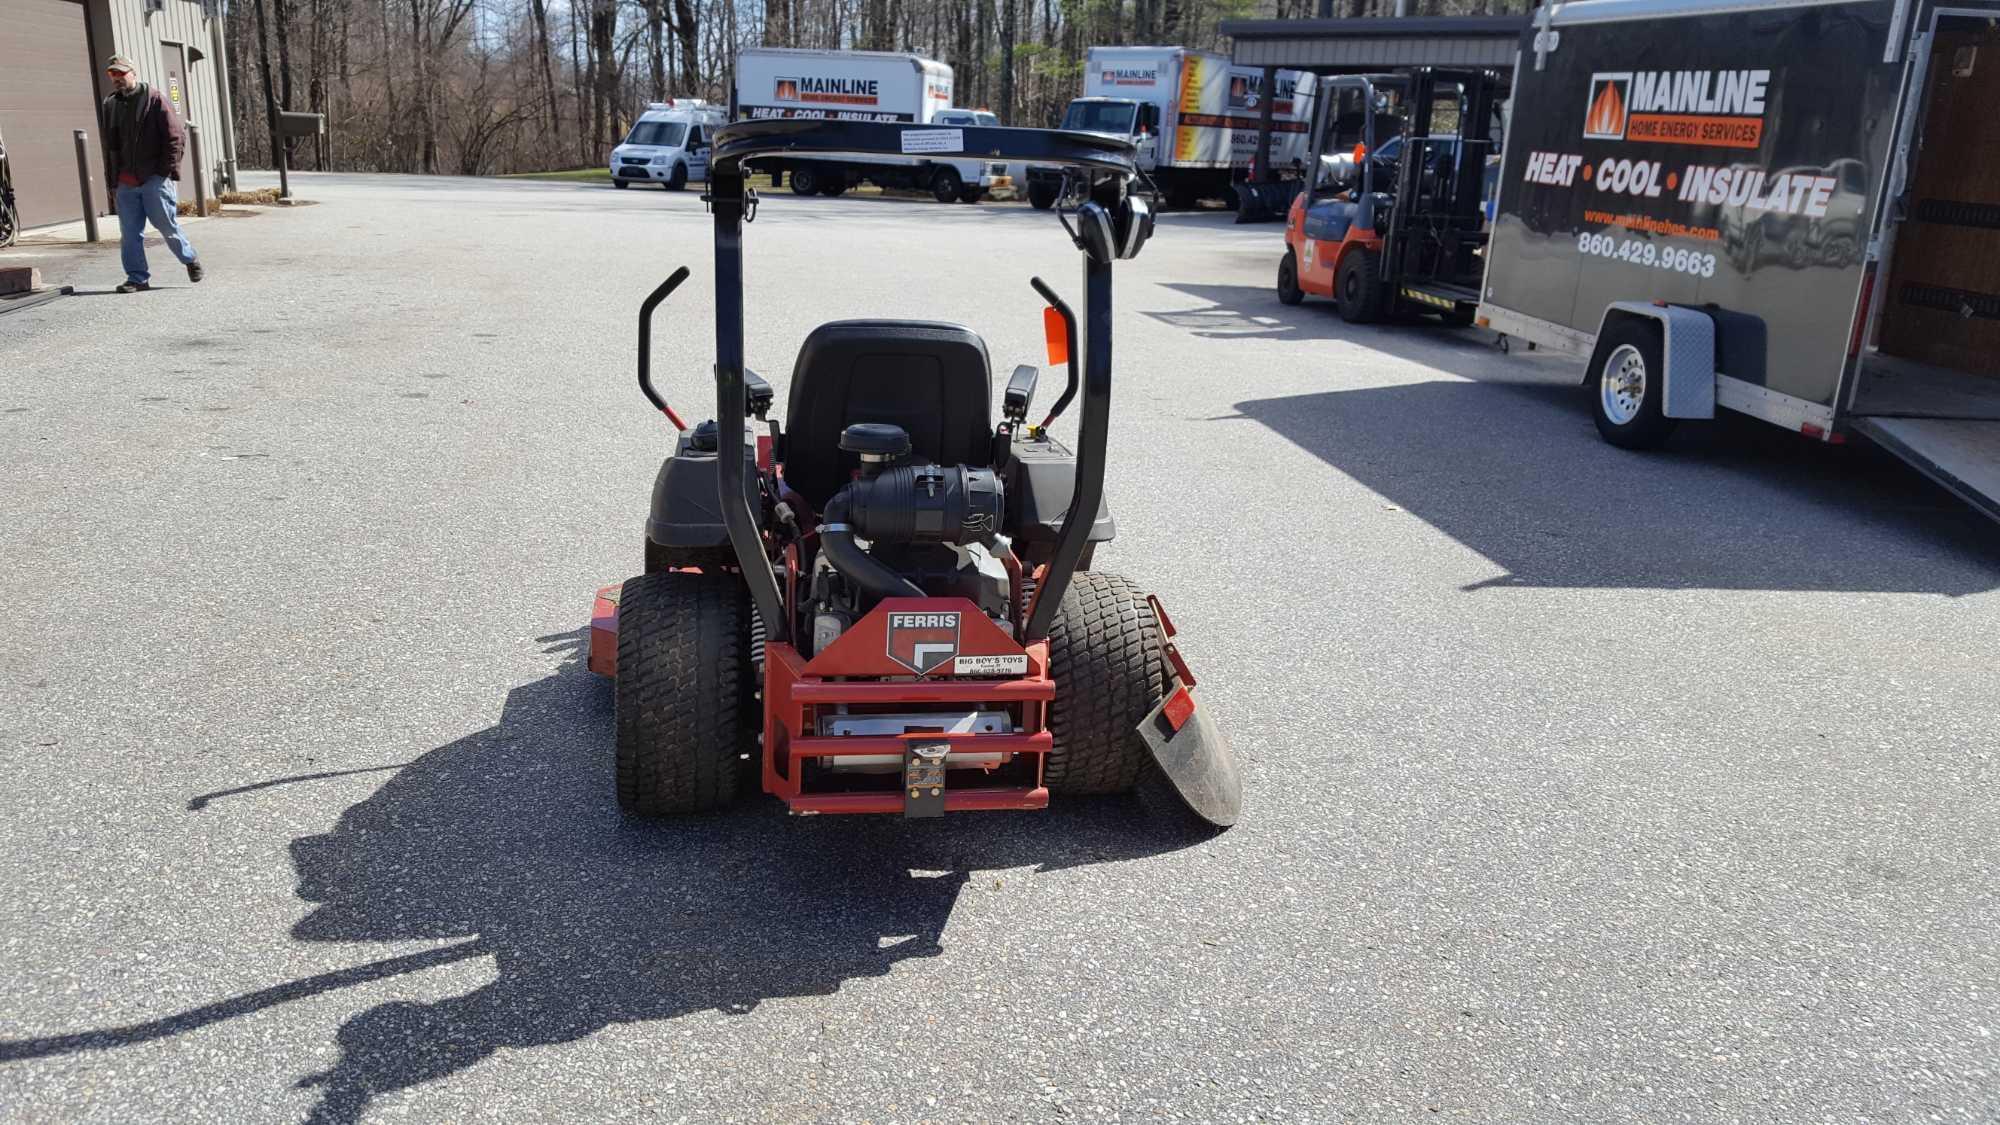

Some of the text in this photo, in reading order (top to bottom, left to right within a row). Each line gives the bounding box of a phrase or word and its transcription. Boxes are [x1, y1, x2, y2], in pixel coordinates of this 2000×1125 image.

[1115, 69, 1157, 80] MAINLINE
[801, 77, 879, 95] MAINLINE
[1631, 69, 1770, 114] MAINLINE
[752, 108, 785, 119] HEAT
[794, 110, 826, 119] COOL
[1631, 119, 1758, 142] HOME ENERGY SERVICES
[1524, 151, 1836, 217] HEAT COOL INSULATE
[1578, 231, 1717, 278] 860.429.9663
[893, 615, 956, 628] FERRIS
[1002, 656, 1023, 664] TOYS
